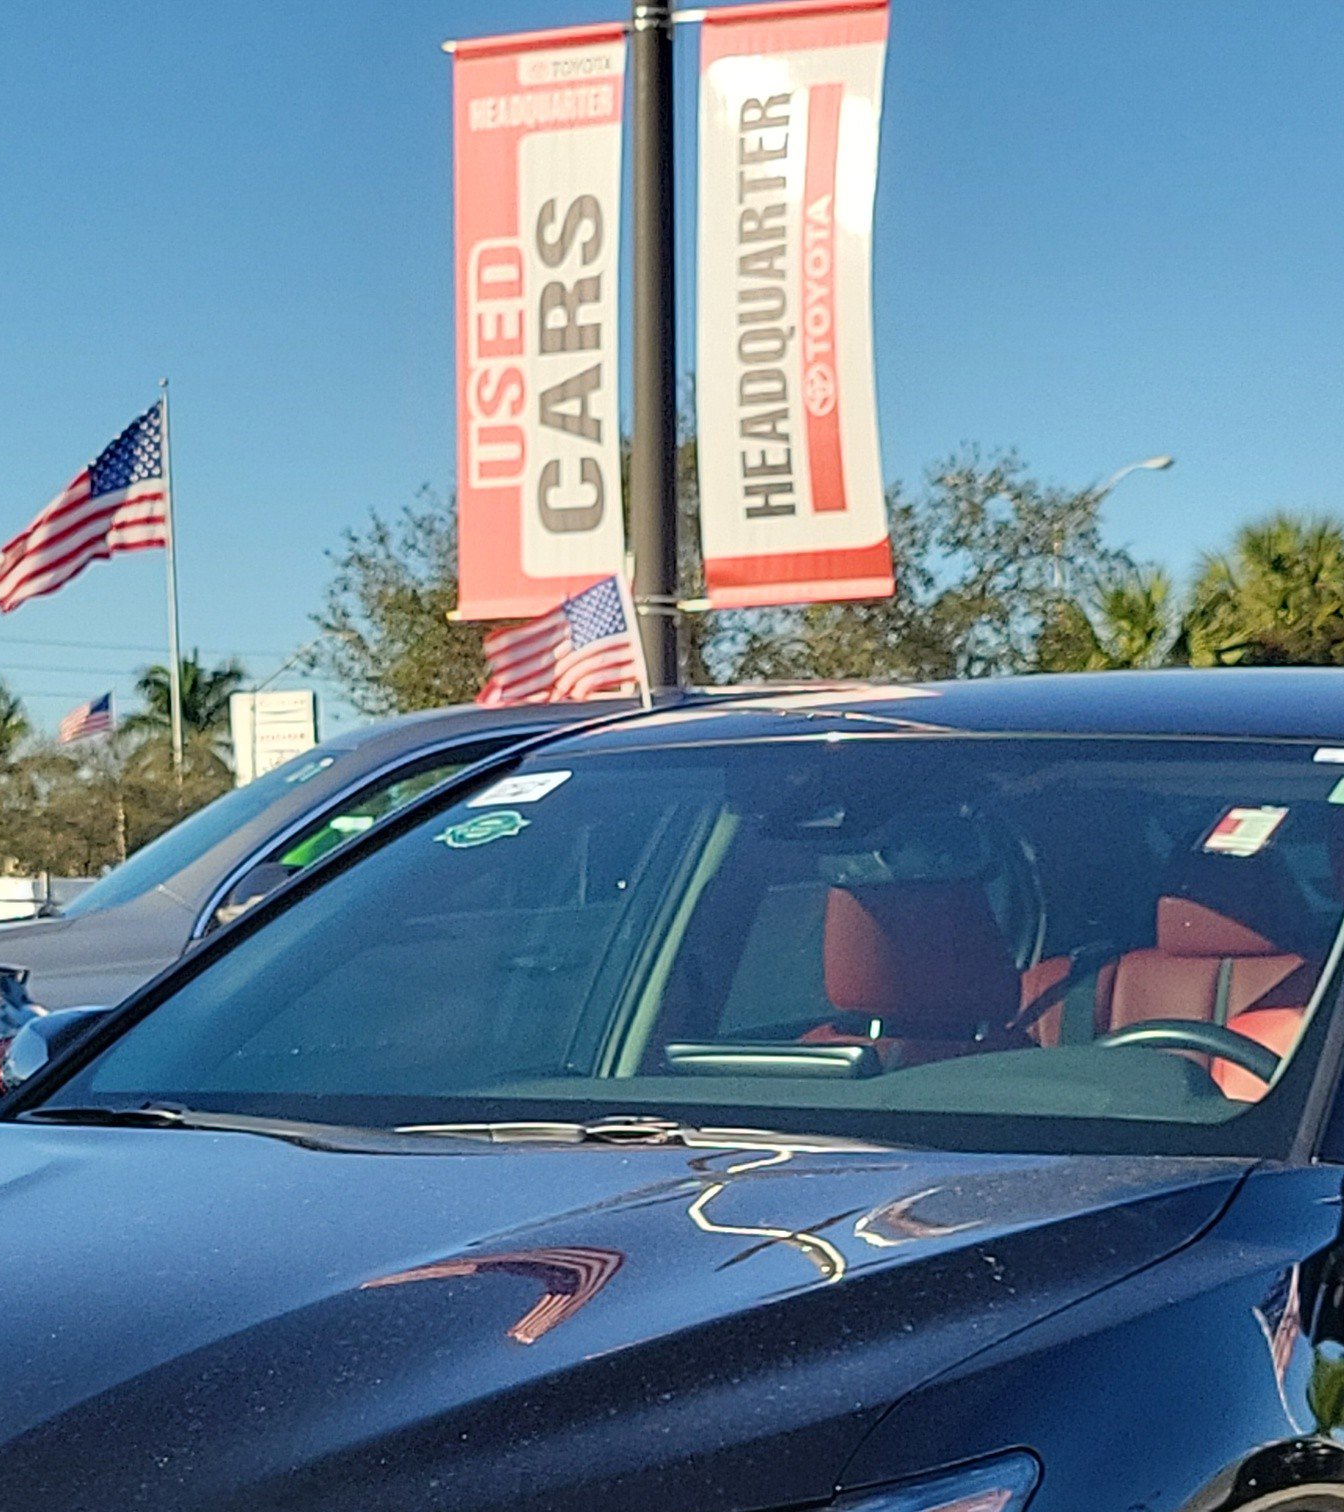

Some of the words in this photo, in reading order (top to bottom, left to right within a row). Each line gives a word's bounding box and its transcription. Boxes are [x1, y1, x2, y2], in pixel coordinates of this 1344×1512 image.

[473, 243, 525, 482] USED
[536, 193, 604, 535] CARS
[737, 91, 797, 520] HEADQUARTER
[804, 200, 834, 362] TOYOTA
